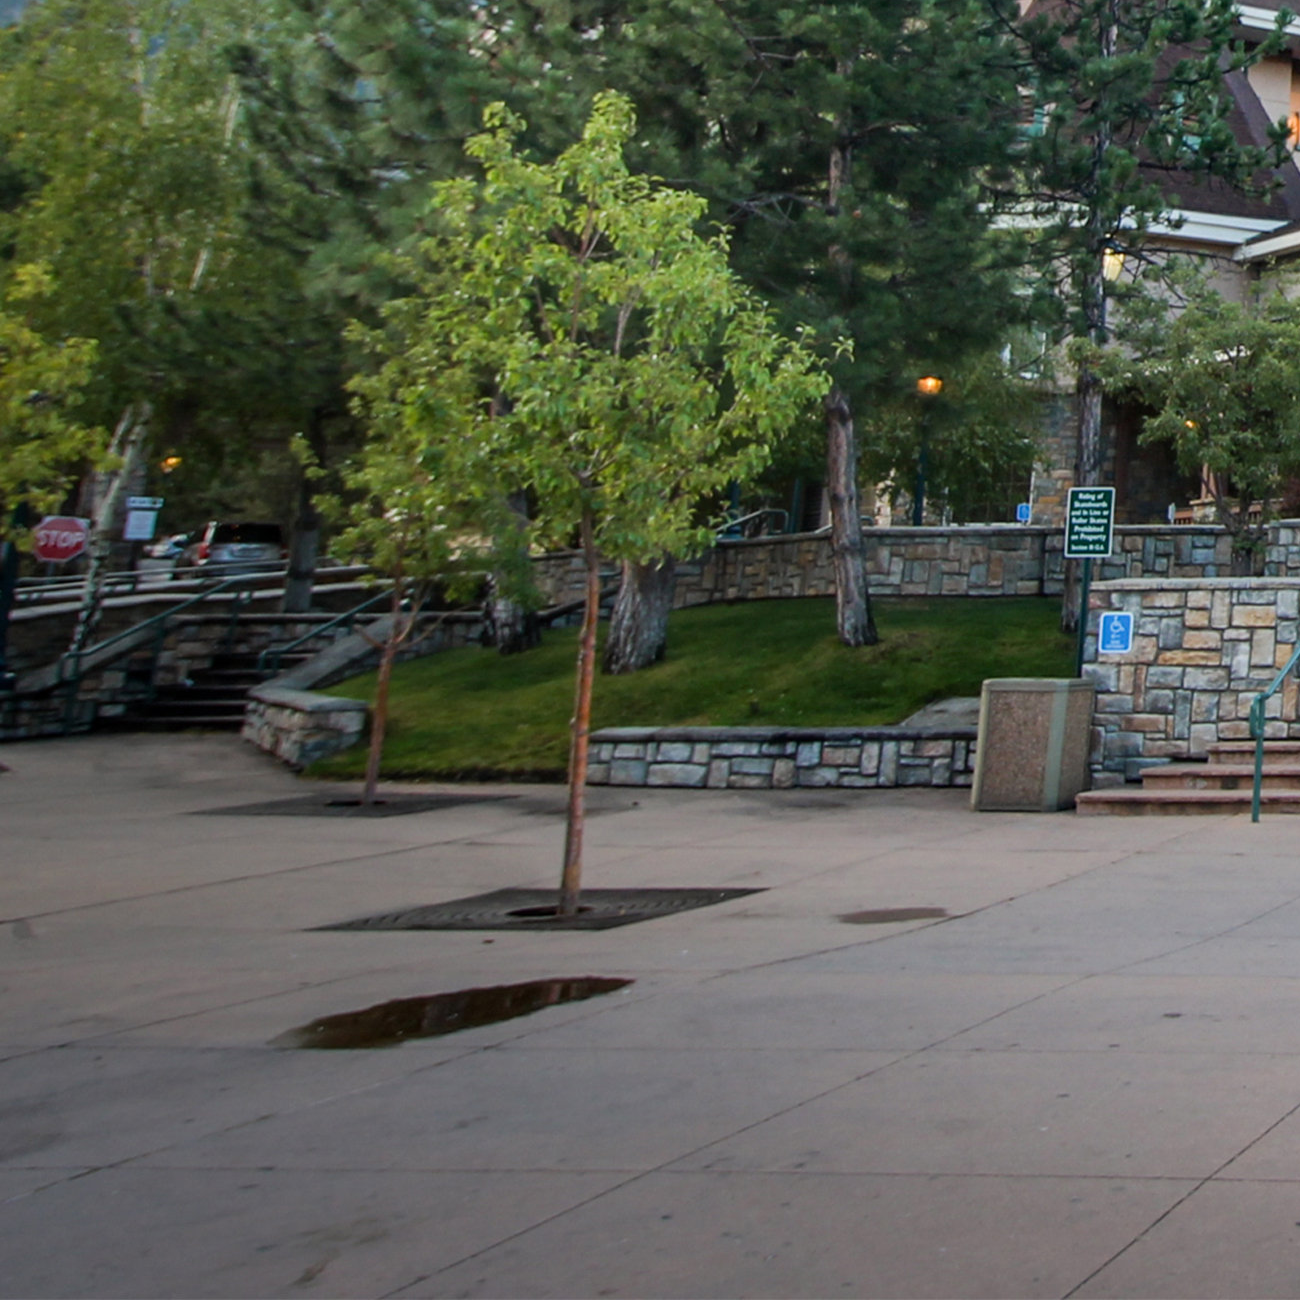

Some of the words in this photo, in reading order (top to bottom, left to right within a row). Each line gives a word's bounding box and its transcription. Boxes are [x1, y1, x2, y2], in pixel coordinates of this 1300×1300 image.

[1078, 493, 1096, 501] Riding
[1096, 492, 1104, 500] of
[37, 530, 85, 548] STOP
[1080, 533, 1106, 542] Property
